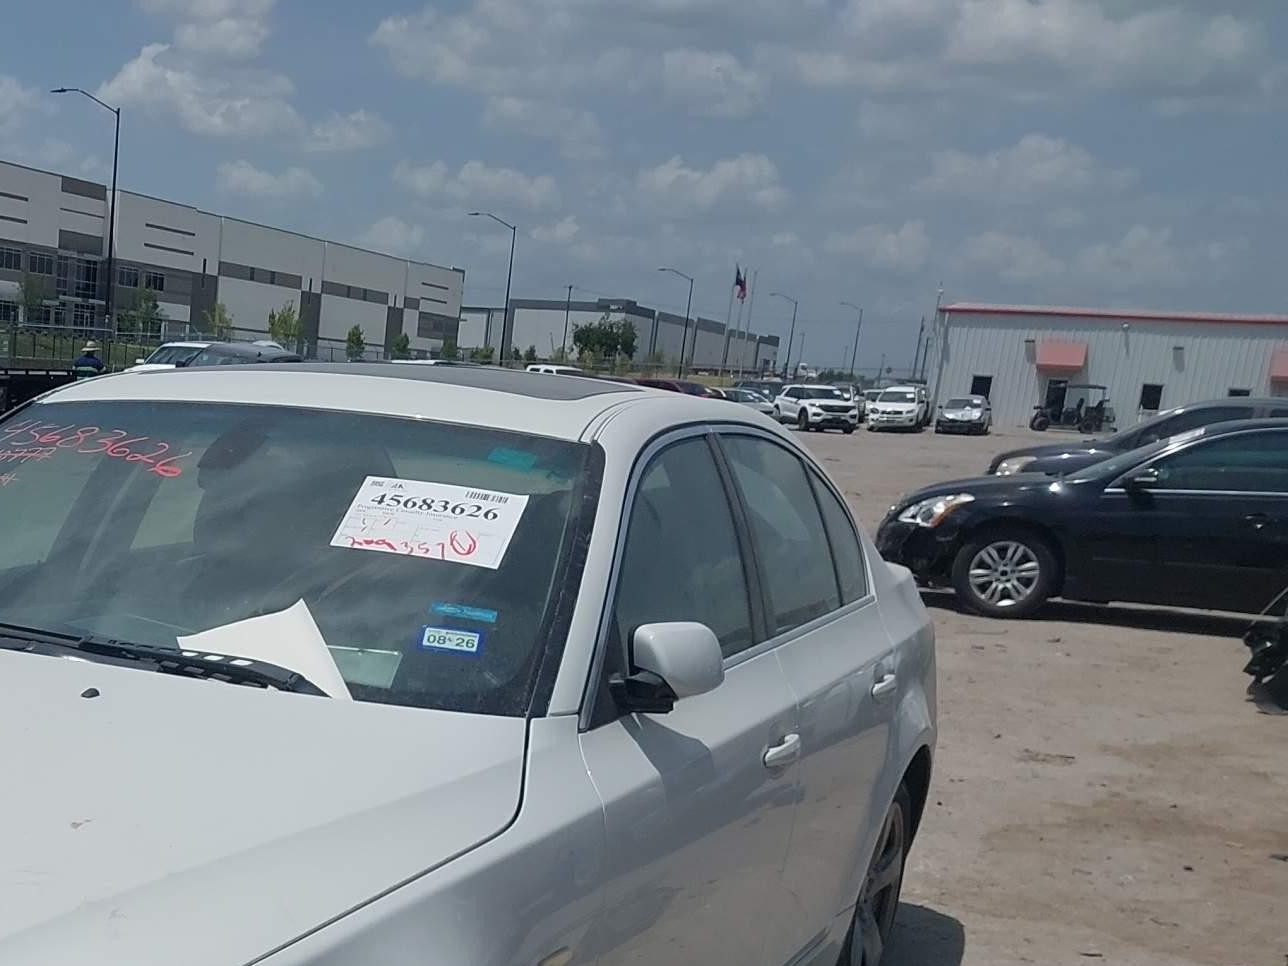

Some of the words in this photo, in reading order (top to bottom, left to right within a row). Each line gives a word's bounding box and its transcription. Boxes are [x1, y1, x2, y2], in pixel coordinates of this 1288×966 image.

[369, 491, 502, 521] 45683626
[427, 633, 447, 645] 08
[455, 637, 476, 649] 26
